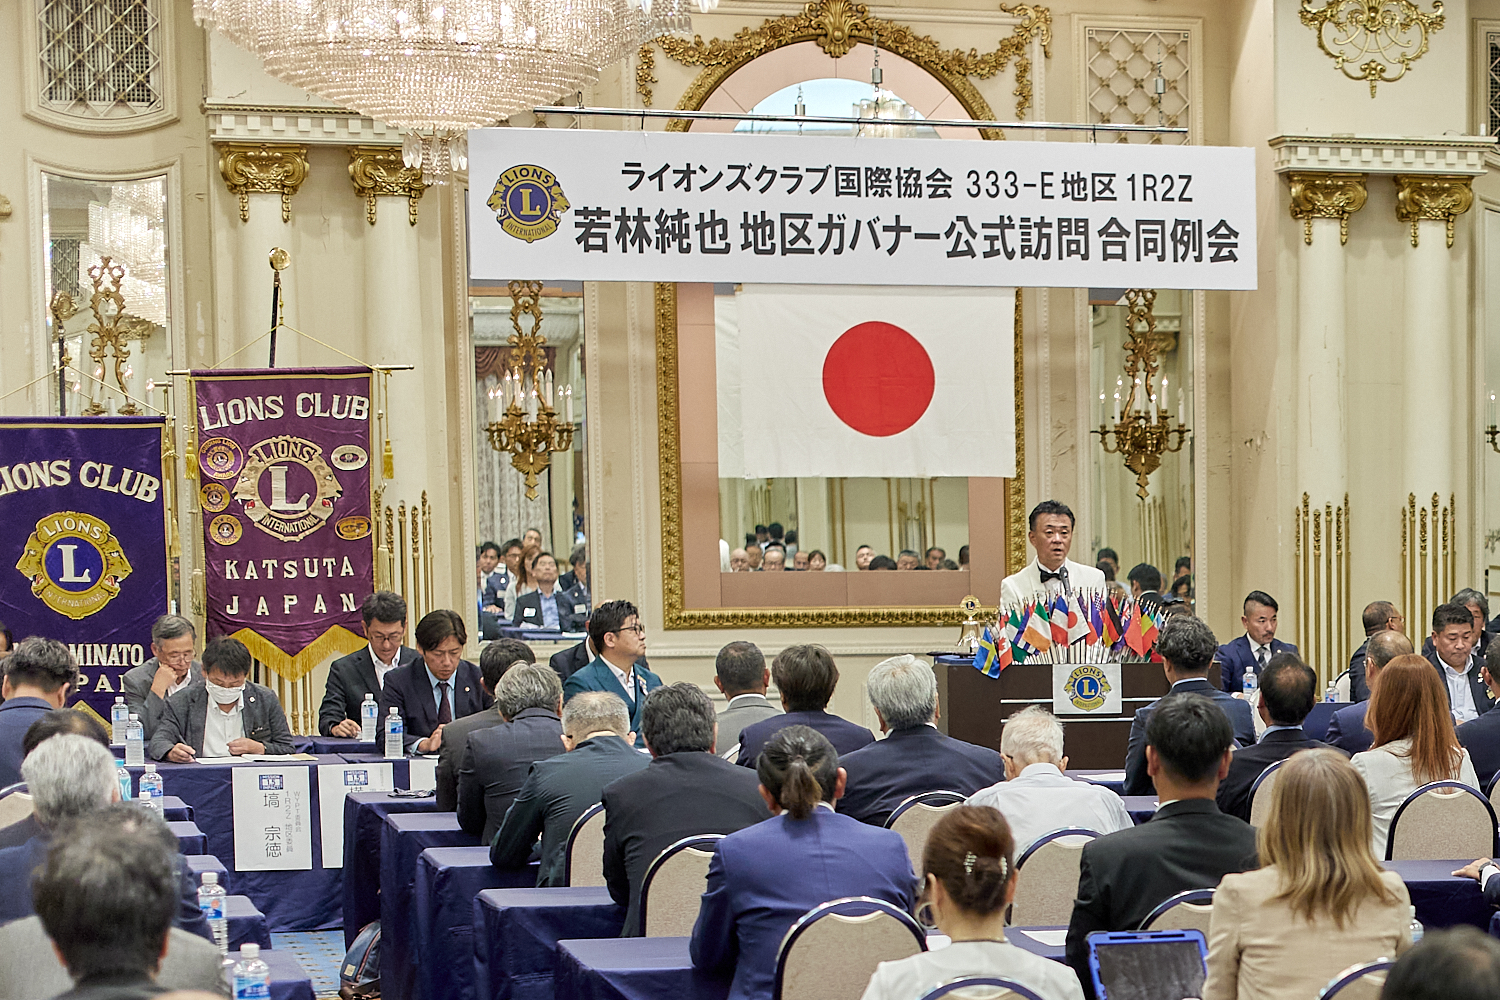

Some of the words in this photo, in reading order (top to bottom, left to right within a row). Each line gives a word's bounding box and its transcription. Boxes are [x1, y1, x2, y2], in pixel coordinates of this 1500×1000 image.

[504, 167, 552, 184] LIONS
[621, 162, 953, 199] ライオンズクラブ国際協会
[1126, 173, 1194, 203] 1R2Z
[519, 188, 541, 215] L
[506, 221, 553, 237] INTERNATIONAL
[573, 206, 732, 255] 若林純也
[199, 395, 284, 431] LIONS
[295, 392, 370, 420] CLUB
[256, 440, 316, 464] LIONS
[0, 459, 71, 496] IONS
[79, 460, 160, 503] CLUB
[268, 465, 311, 511] L
[42, 517, 103, 540] LIONS
[261, 514, 320, 533] INTERNATIONAL
[57, 544, 91, 583] L
[224, 555, 355, 580] KATSUTA
[45, 587, 106, 608] INTERNATIONAL
[225, 593, 357, 616] JAPAN
[1074, 667, 1101, 677] LIONS
[1082, 679, 1095, 696] L
